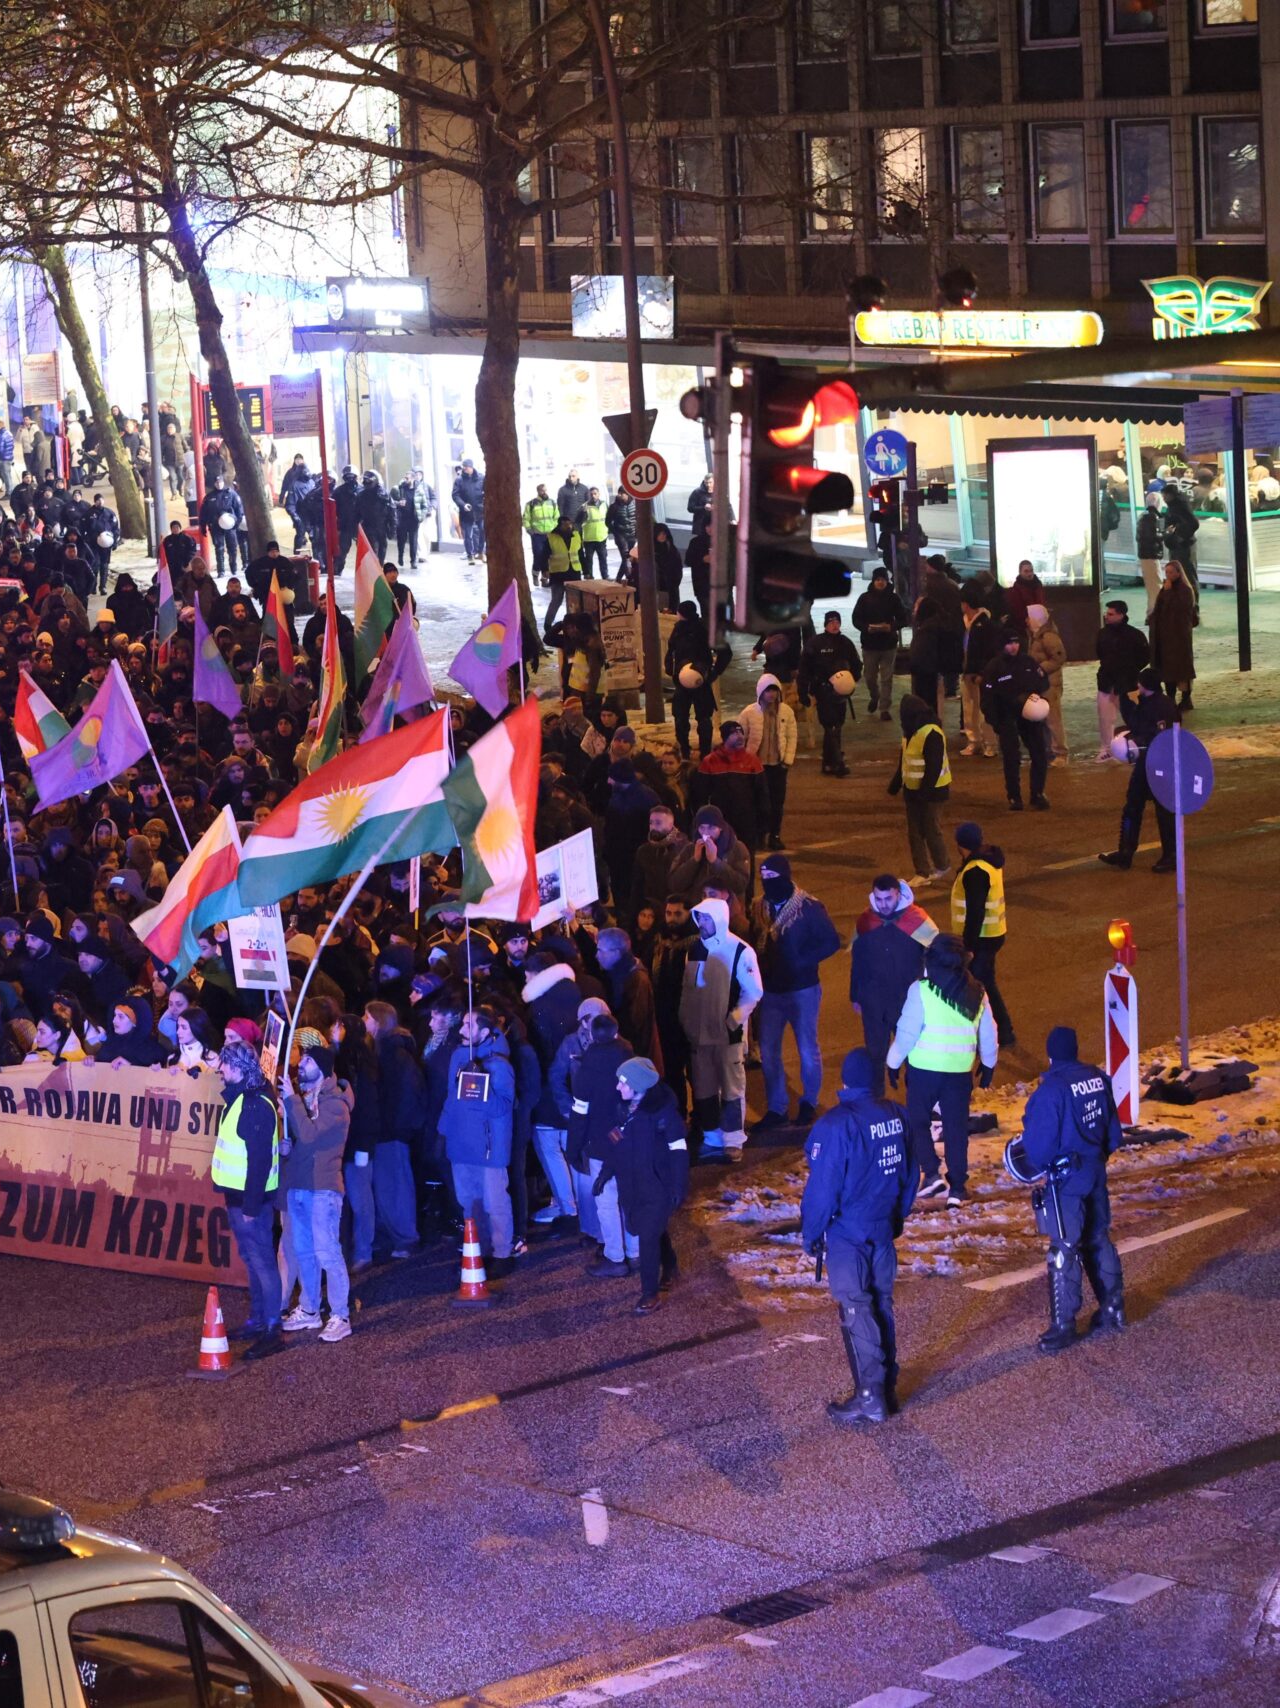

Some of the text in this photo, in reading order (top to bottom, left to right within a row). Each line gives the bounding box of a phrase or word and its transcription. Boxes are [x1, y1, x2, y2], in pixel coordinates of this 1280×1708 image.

[631, 463, 658, 486] 30
[23, 1086, 121, 1126] ROJAVA
[129, 1095, 182, 1132] UND
[1084, 1099, 1097, 1112] HH
[882, 1144, 897, 1157] HH
[104, 1195, 232, 1269] KRIEG
